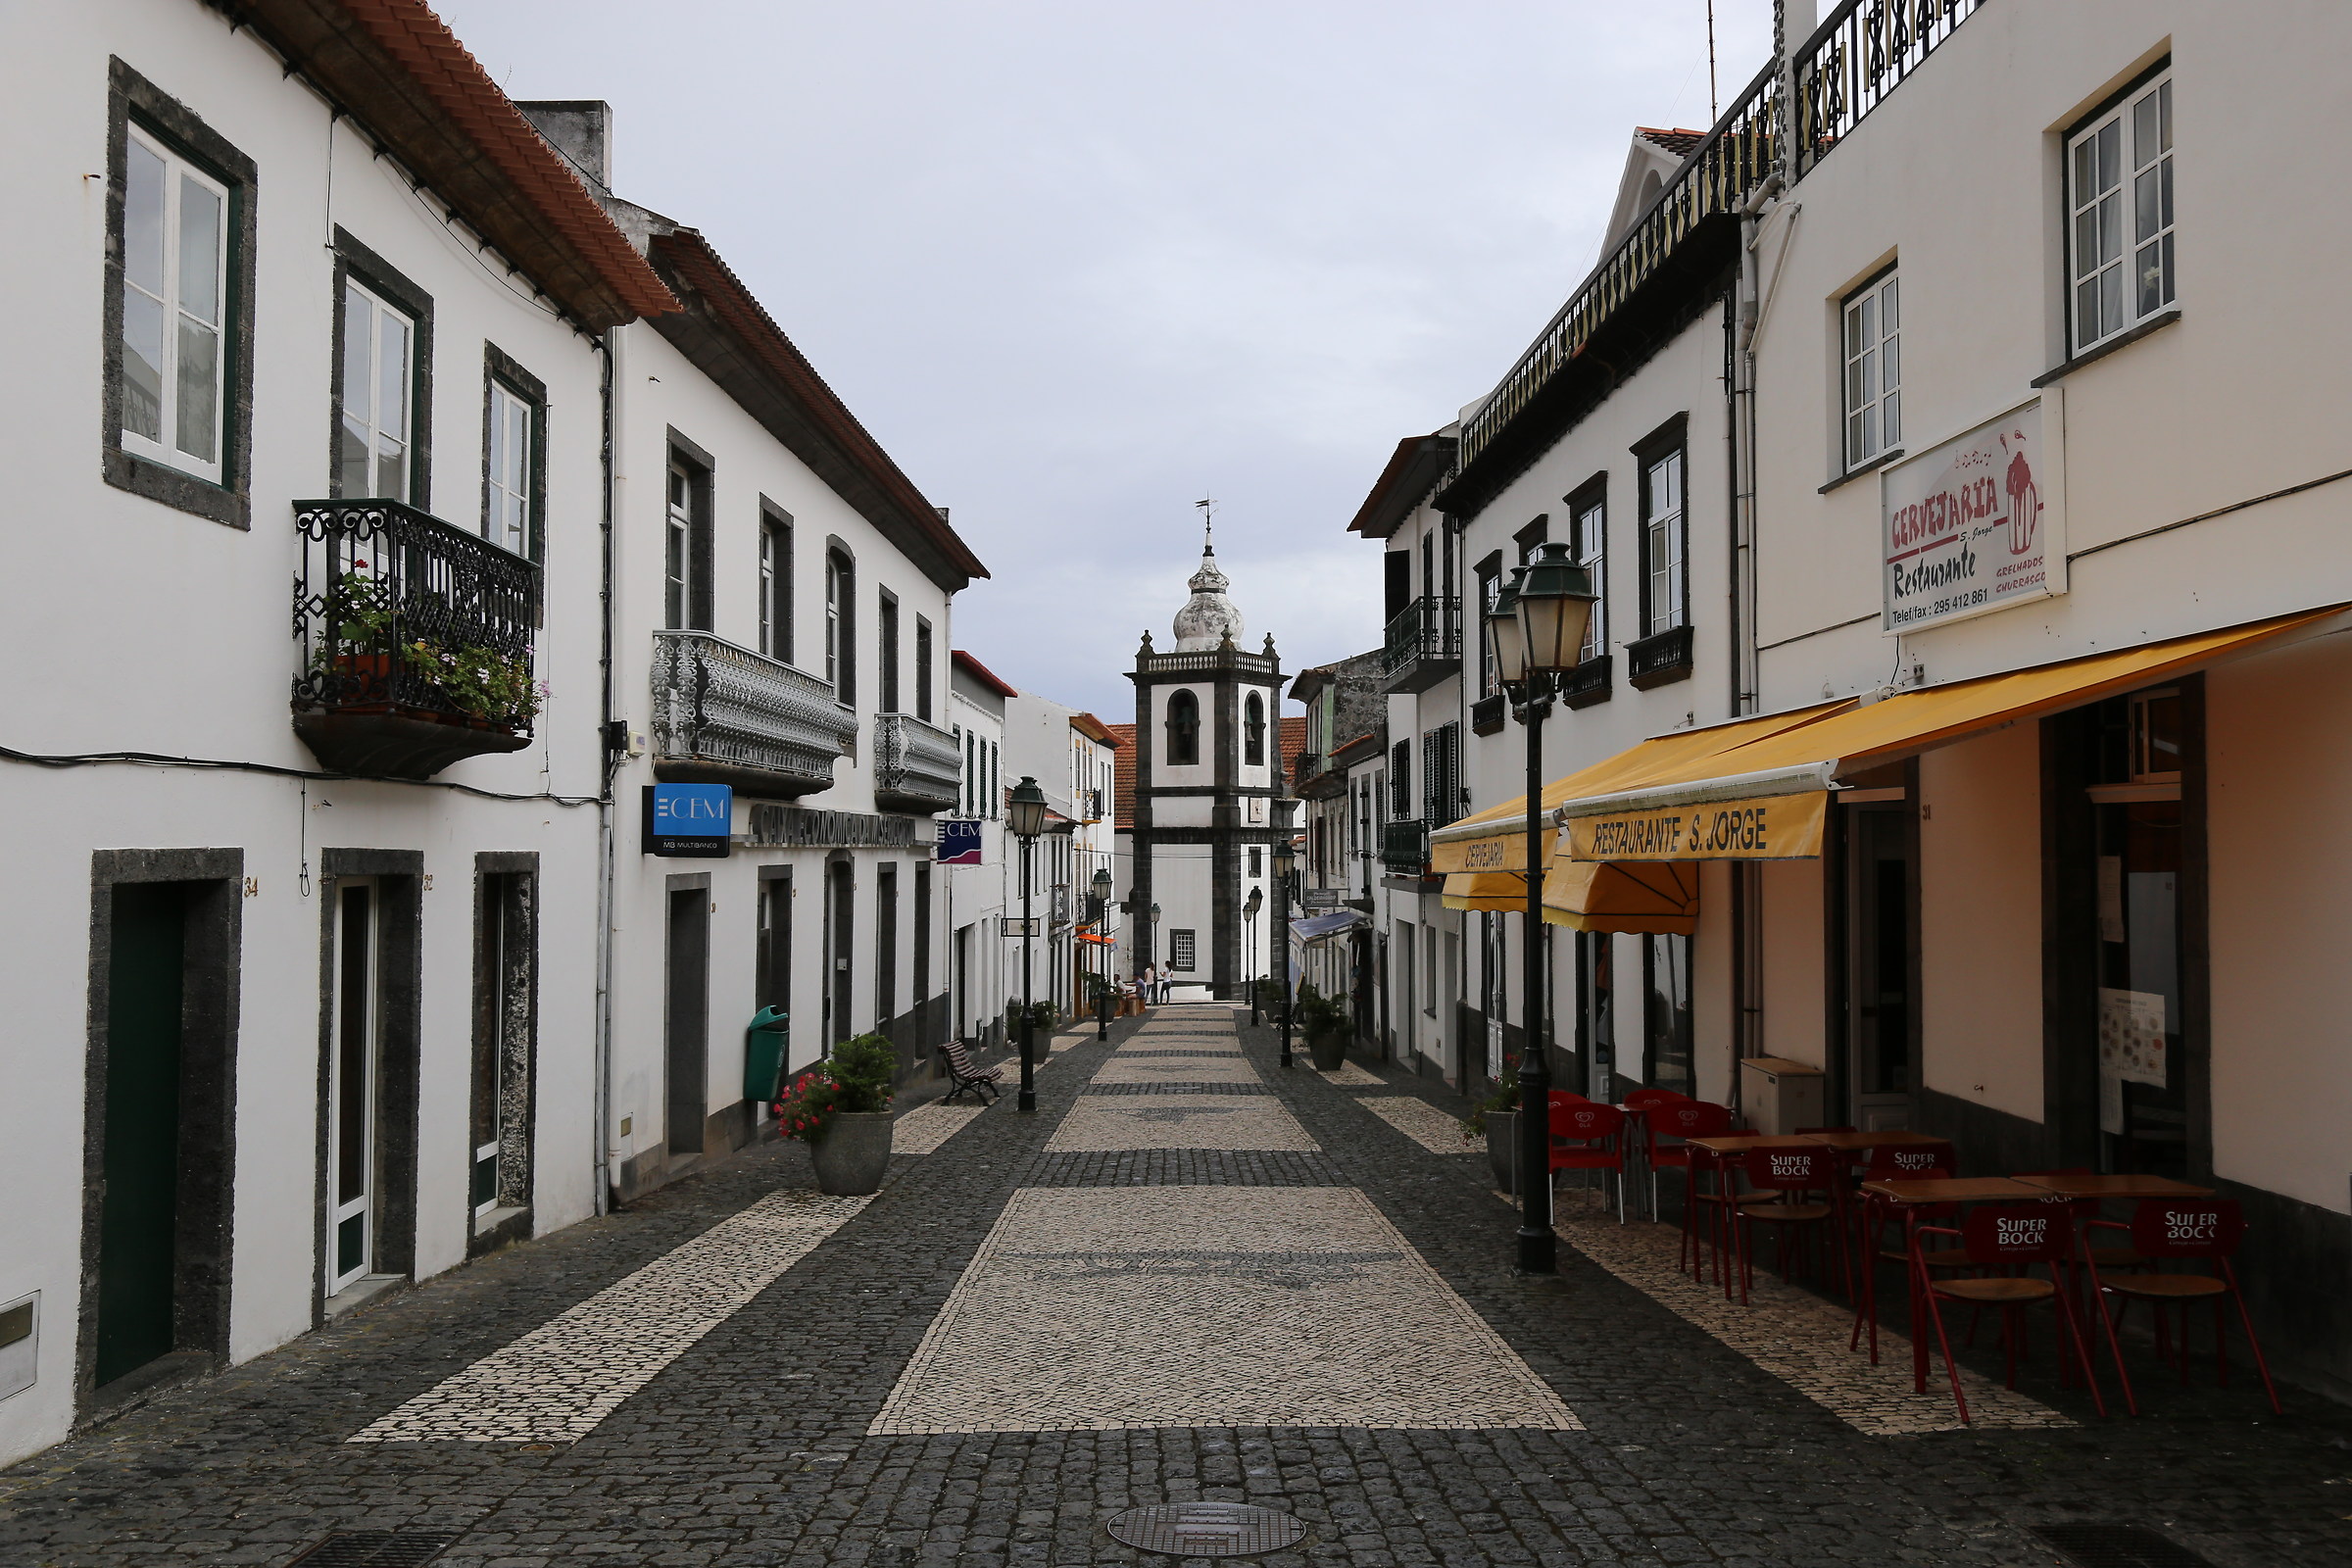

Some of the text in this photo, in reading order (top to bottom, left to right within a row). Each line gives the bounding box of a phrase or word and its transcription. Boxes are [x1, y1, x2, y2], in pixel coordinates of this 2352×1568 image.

[1891, 476, 1998, 549] CERVEJARIA
[1893, 542, 1976, 600] Restaurante
[1996, 556, 2043, 577] GRELHADOS
[1934, 597, 1950, 615] 295
[1952, 592, 1970, 611] 412
[1972, 588, 1988, 606] 861
[1592, 816, 1681, 855] RESTAURANTE
[1706, 808, 1767, 851] JORGE
[1465, 841, 1504, 868] CERVEJARIA
[244, 876, 259, 898] 34
[1771, 1154, 1811, 1166] SUPER
[1895, 1152, 1935, 1164] SUPER
[1773, 1165, 1810, 1176] BOCK
[1997, 1217, 2047, 1232] SUPER
[1998, 1231, 2044, 1245] BOCK
